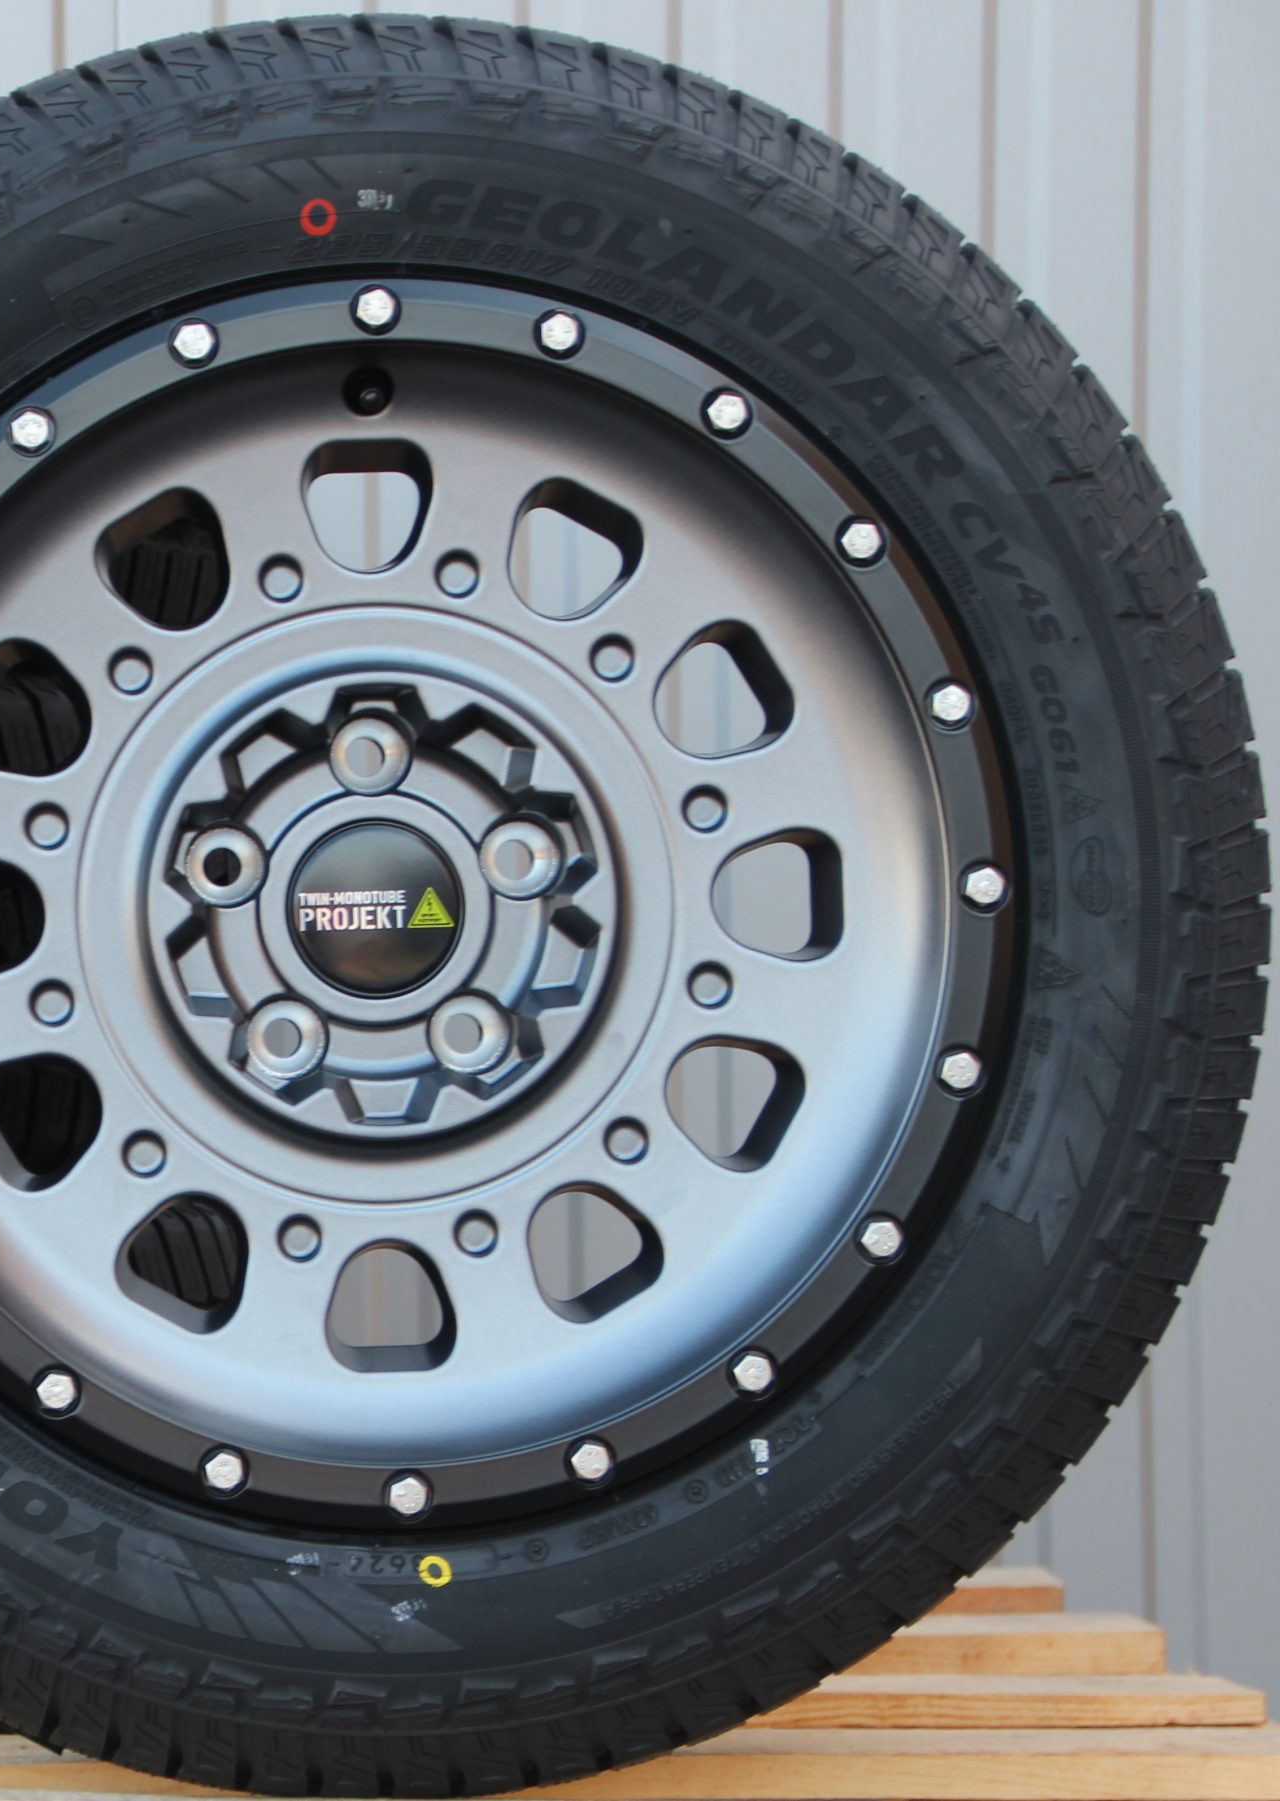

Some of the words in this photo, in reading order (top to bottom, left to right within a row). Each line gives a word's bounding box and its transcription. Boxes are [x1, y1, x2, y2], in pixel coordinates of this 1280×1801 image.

[407, 176, 966, 493] GEOLANDAR
[298, 890, 406, 906] TWIN-MONOTUBE
[299, 905, 407, 932] PROJEKT
